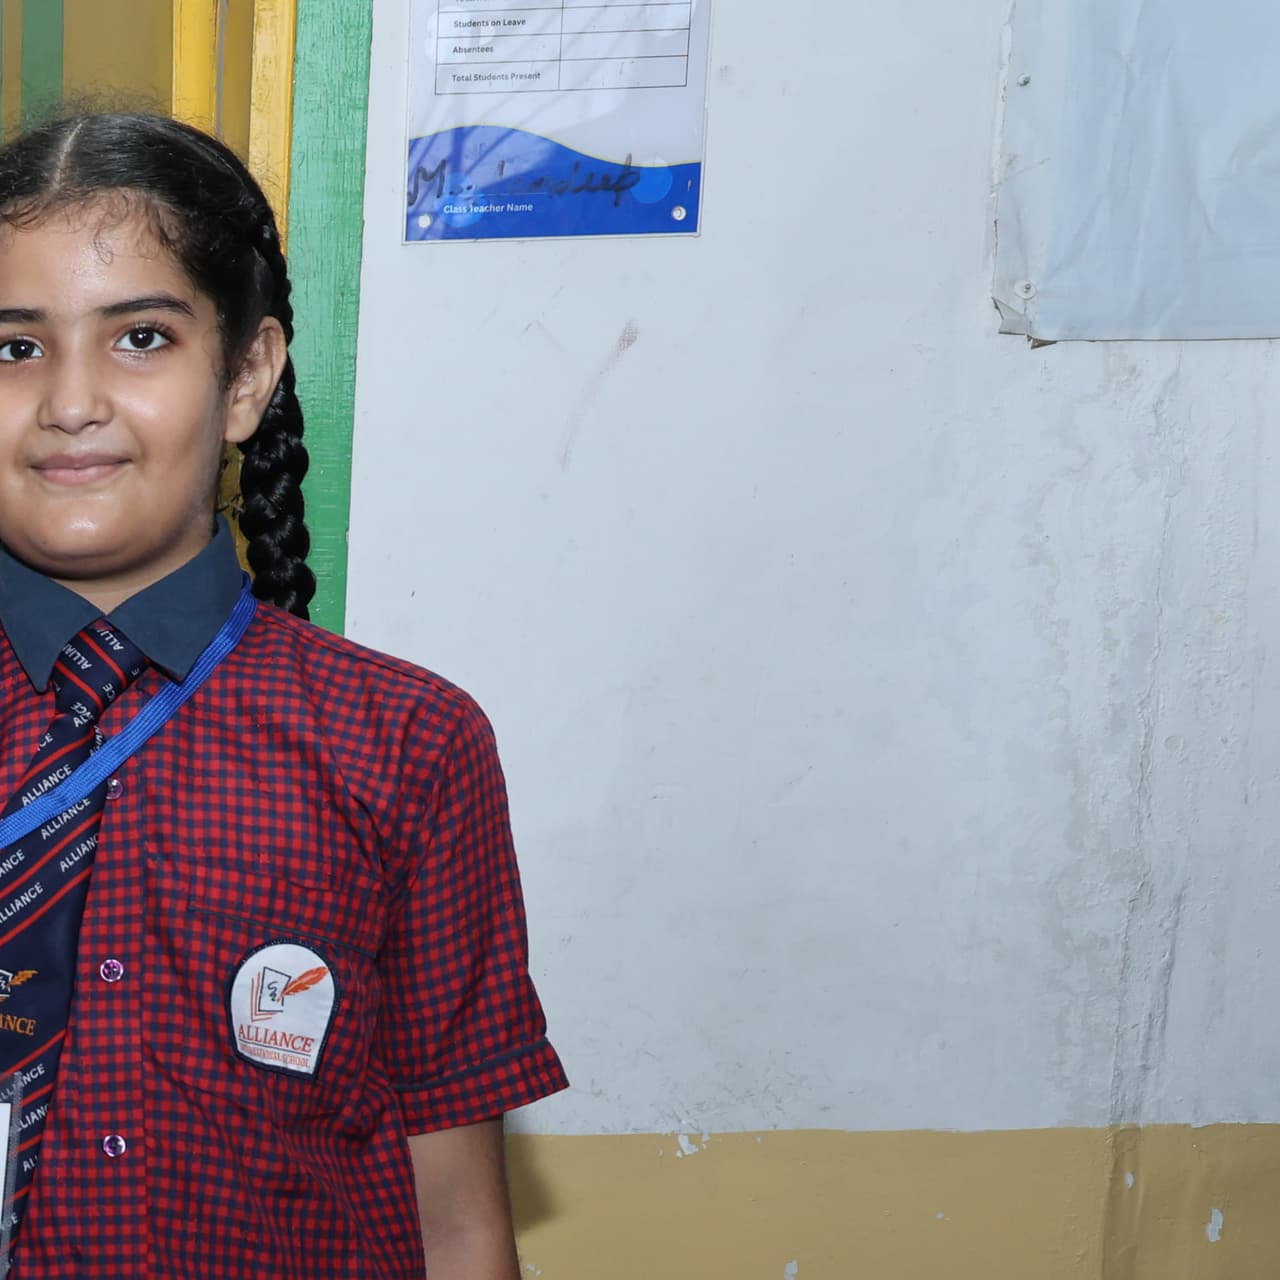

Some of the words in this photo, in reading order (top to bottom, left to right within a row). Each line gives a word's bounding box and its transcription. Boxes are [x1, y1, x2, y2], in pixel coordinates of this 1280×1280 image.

[454, 19, 489, 28] Students
[502, 18, 527, 27] Leave
[452, 45, 494, 54] Absentees
[452, 73, 472, 82] Total
[473, 73, 509, 82] Students
[510, 72, 541, 81] Present
[443, 203, 468, 214] Class
[469, 202, 505, 213] Teacher
[506, 202, 534, 212] Name
[21, 764, 73, 807] ALLIANCE
[40, 797, 91, 840] ALLIANCE
[239, 1023, 315, 1053] ALLIANCE
